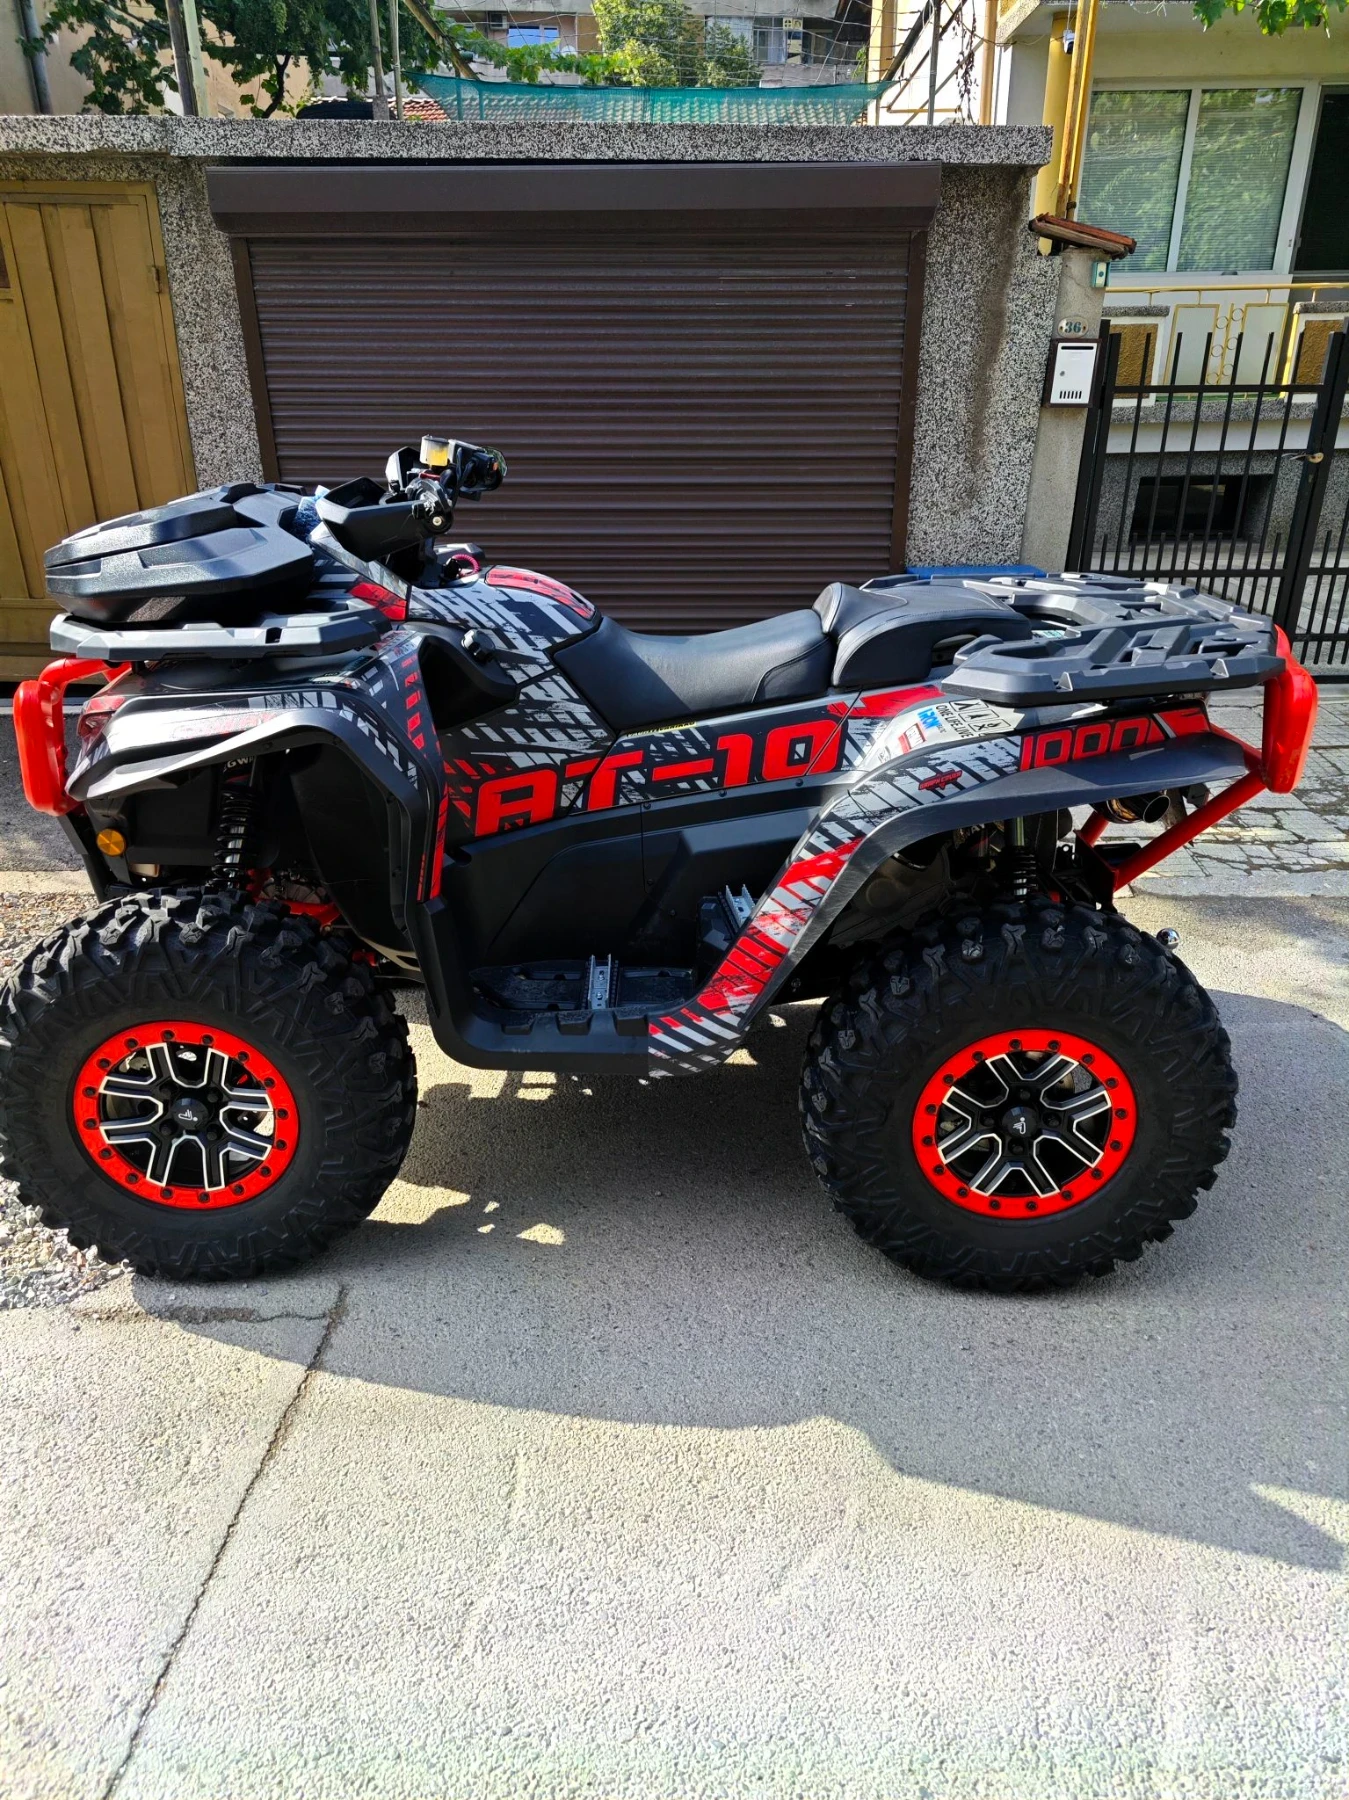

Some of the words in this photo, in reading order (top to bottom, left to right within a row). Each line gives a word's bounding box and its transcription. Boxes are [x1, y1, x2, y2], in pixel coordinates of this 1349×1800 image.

[1065, 321, 1082, 333] 36
[936, 704, 953, 716] ONE
[1020, 717, 1149, 771] 1000
[475, 719, 842, 837] AT-10
